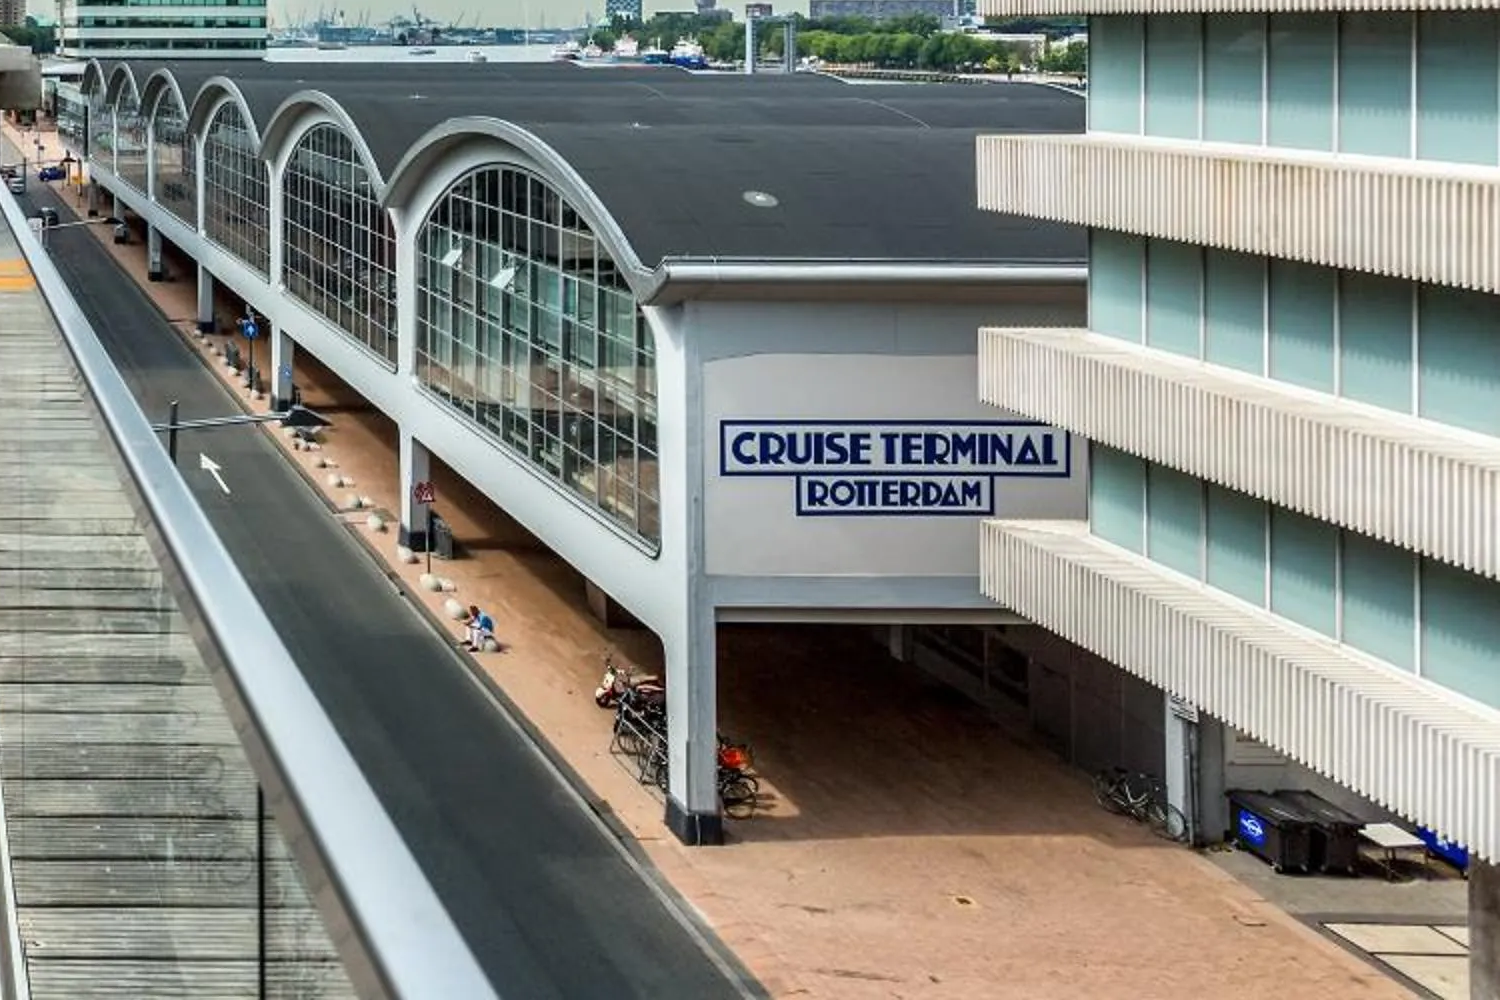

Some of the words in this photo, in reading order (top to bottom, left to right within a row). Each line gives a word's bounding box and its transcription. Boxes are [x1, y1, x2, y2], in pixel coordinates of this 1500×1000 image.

[731, 431, 872, 465] CRUISE
[879, 432, 1059, 466] TERMINAL
[807, 479, 982, 507] ROTTERDAM
